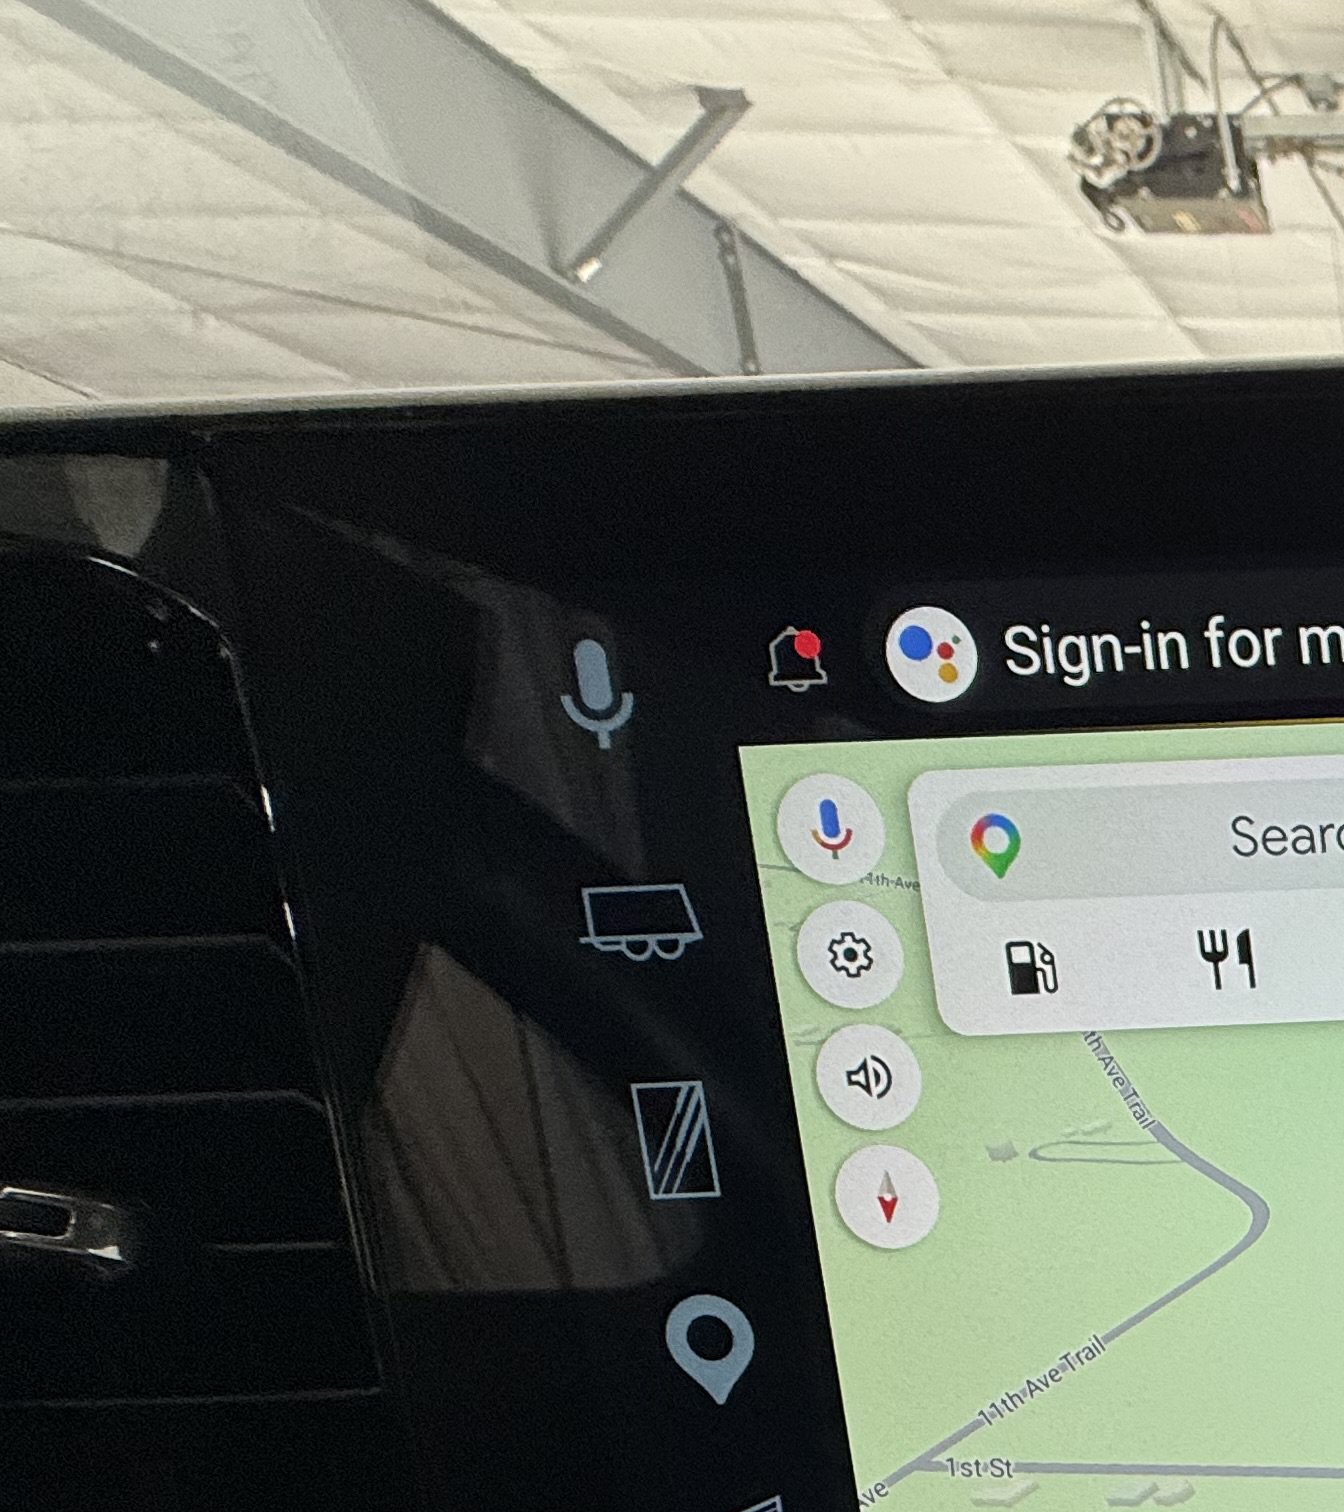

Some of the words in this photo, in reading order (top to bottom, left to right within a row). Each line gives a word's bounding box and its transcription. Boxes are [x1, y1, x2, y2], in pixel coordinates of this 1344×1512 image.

[1003, 619, 1190, 687] Sign-in
[1203, 614, 1283, 668] for
[1097, 1055, 1125, 1089] Ave
[1123, 1087, 1156, 1130] Trail
[977, 1391, 1025, 1426] 11th
[1026, 1367, 1063, 1399] Ave
[1058, 1333, 1106, 1372] Trail
[946, 1457, 982, 1478] 1st
[989, 1457, 1014, 1478] St
